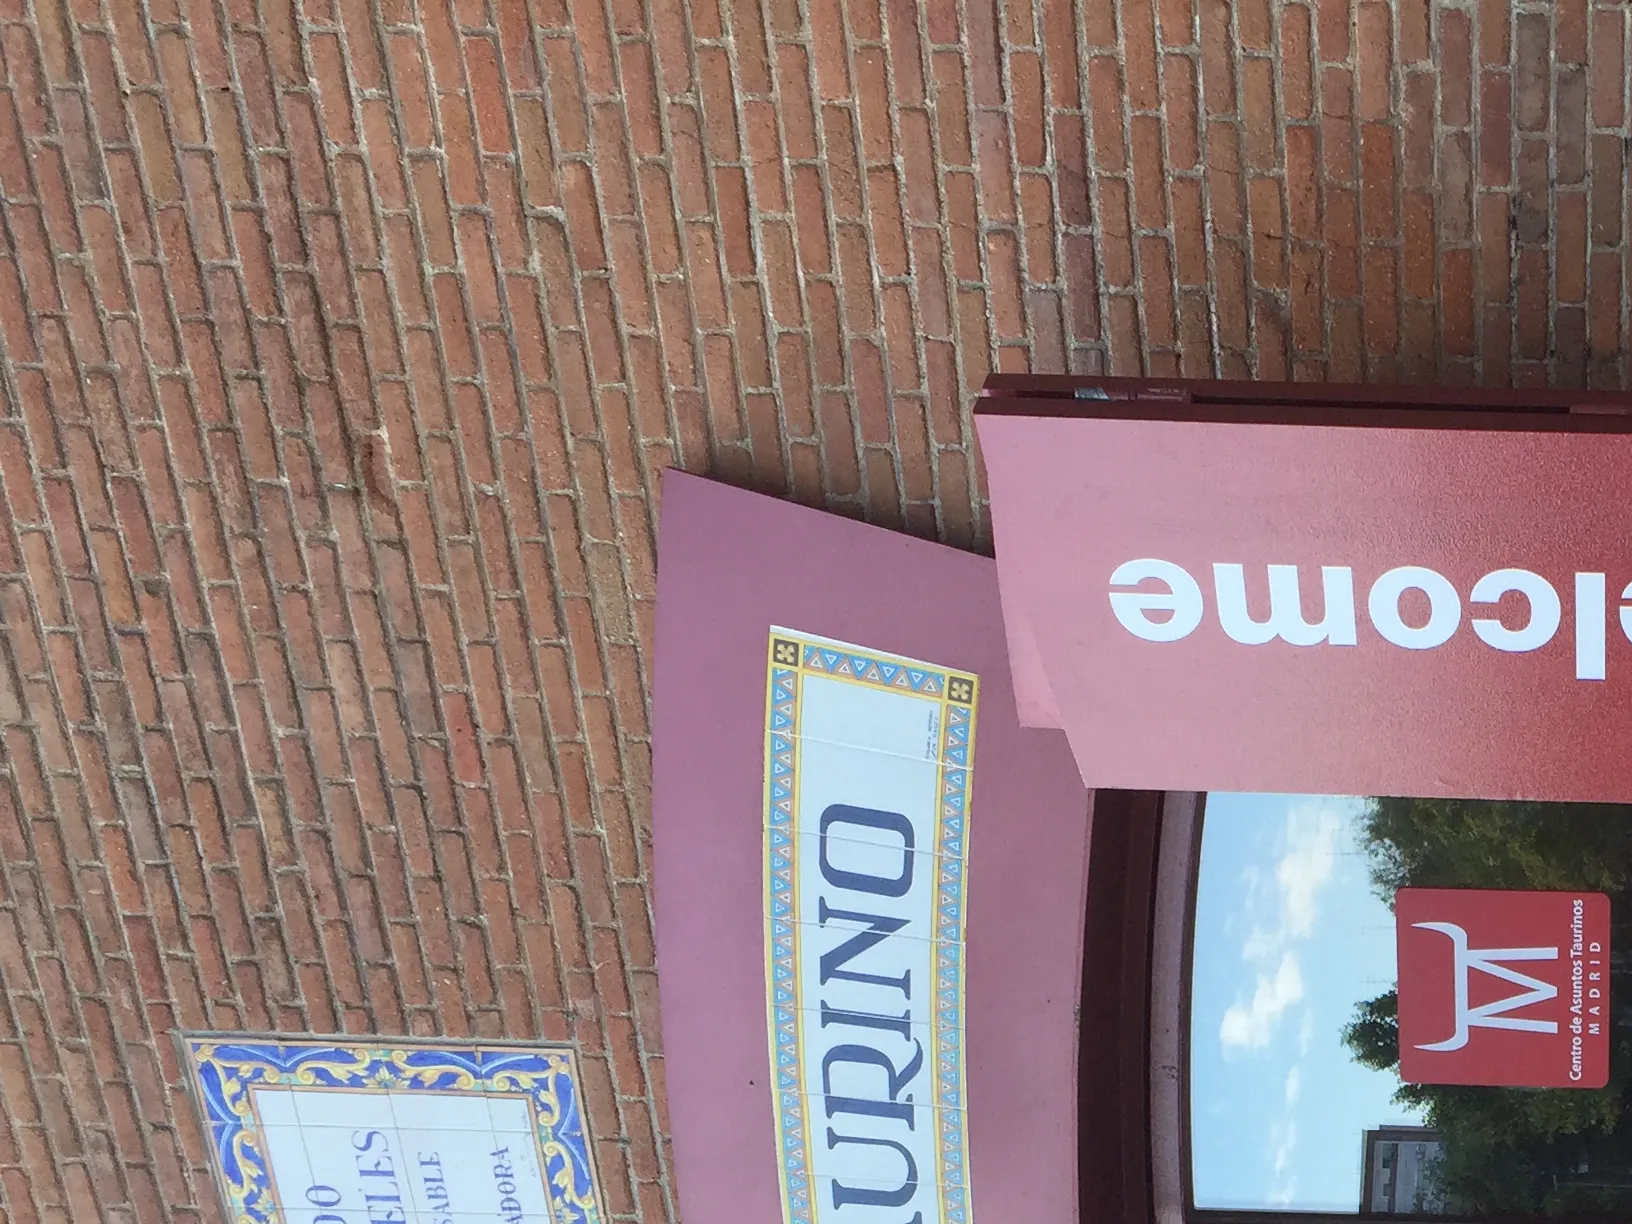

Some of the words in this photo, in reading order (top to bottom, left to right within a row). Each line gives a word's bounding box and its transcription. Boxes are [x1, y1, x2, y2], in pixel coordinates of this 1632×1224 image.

[1570, 899, 1584, 958] Taurinos
[1569, 960, 1583, 1014] Asuntos
[1588, 942, 1600, 1035] MADRID
[1569, 1017, 1583, 1034] de
[1569, 1037, 1583, 1081] Centro
